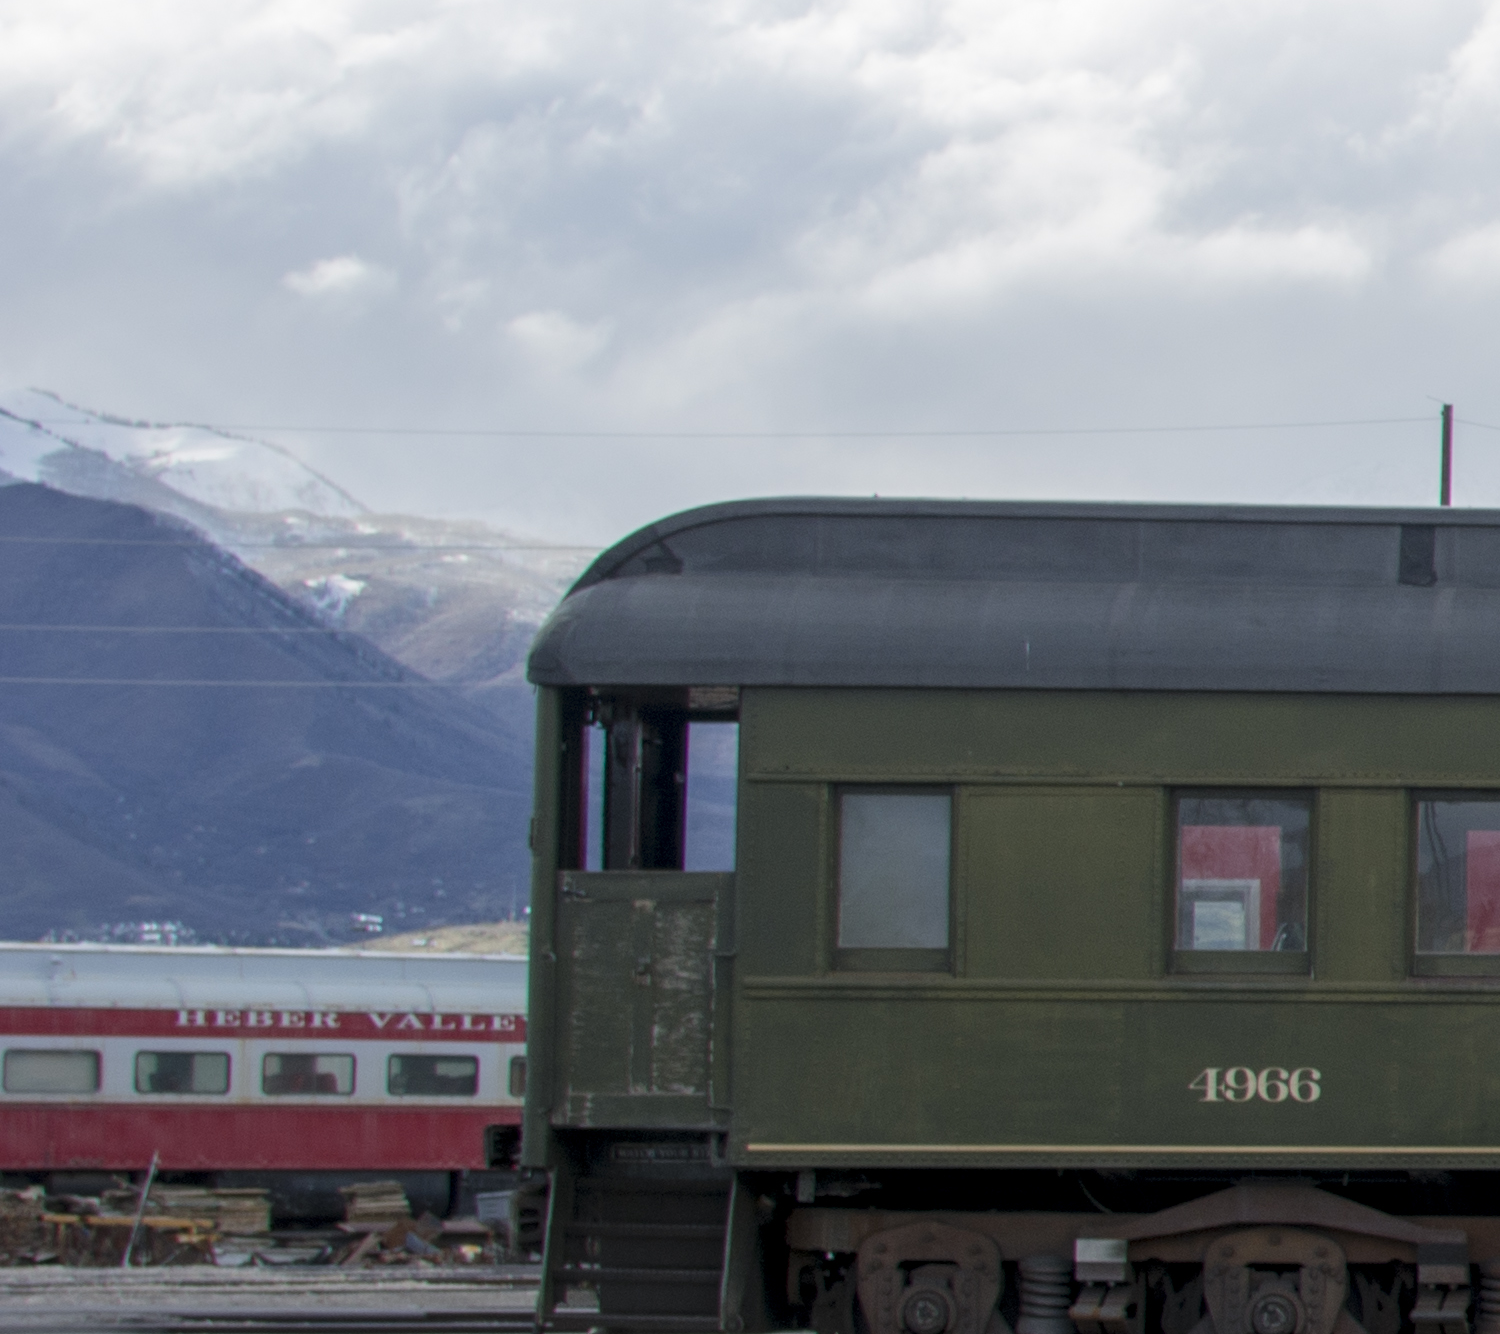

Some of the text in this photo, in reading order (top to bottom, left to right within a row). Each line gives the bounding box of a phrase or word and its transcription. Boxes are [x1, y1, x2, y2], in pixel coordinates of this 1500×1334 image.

[174, 1010, 527, 1031] HEBER VALLE
[1187, 1066, 1322, 1103] 4966
